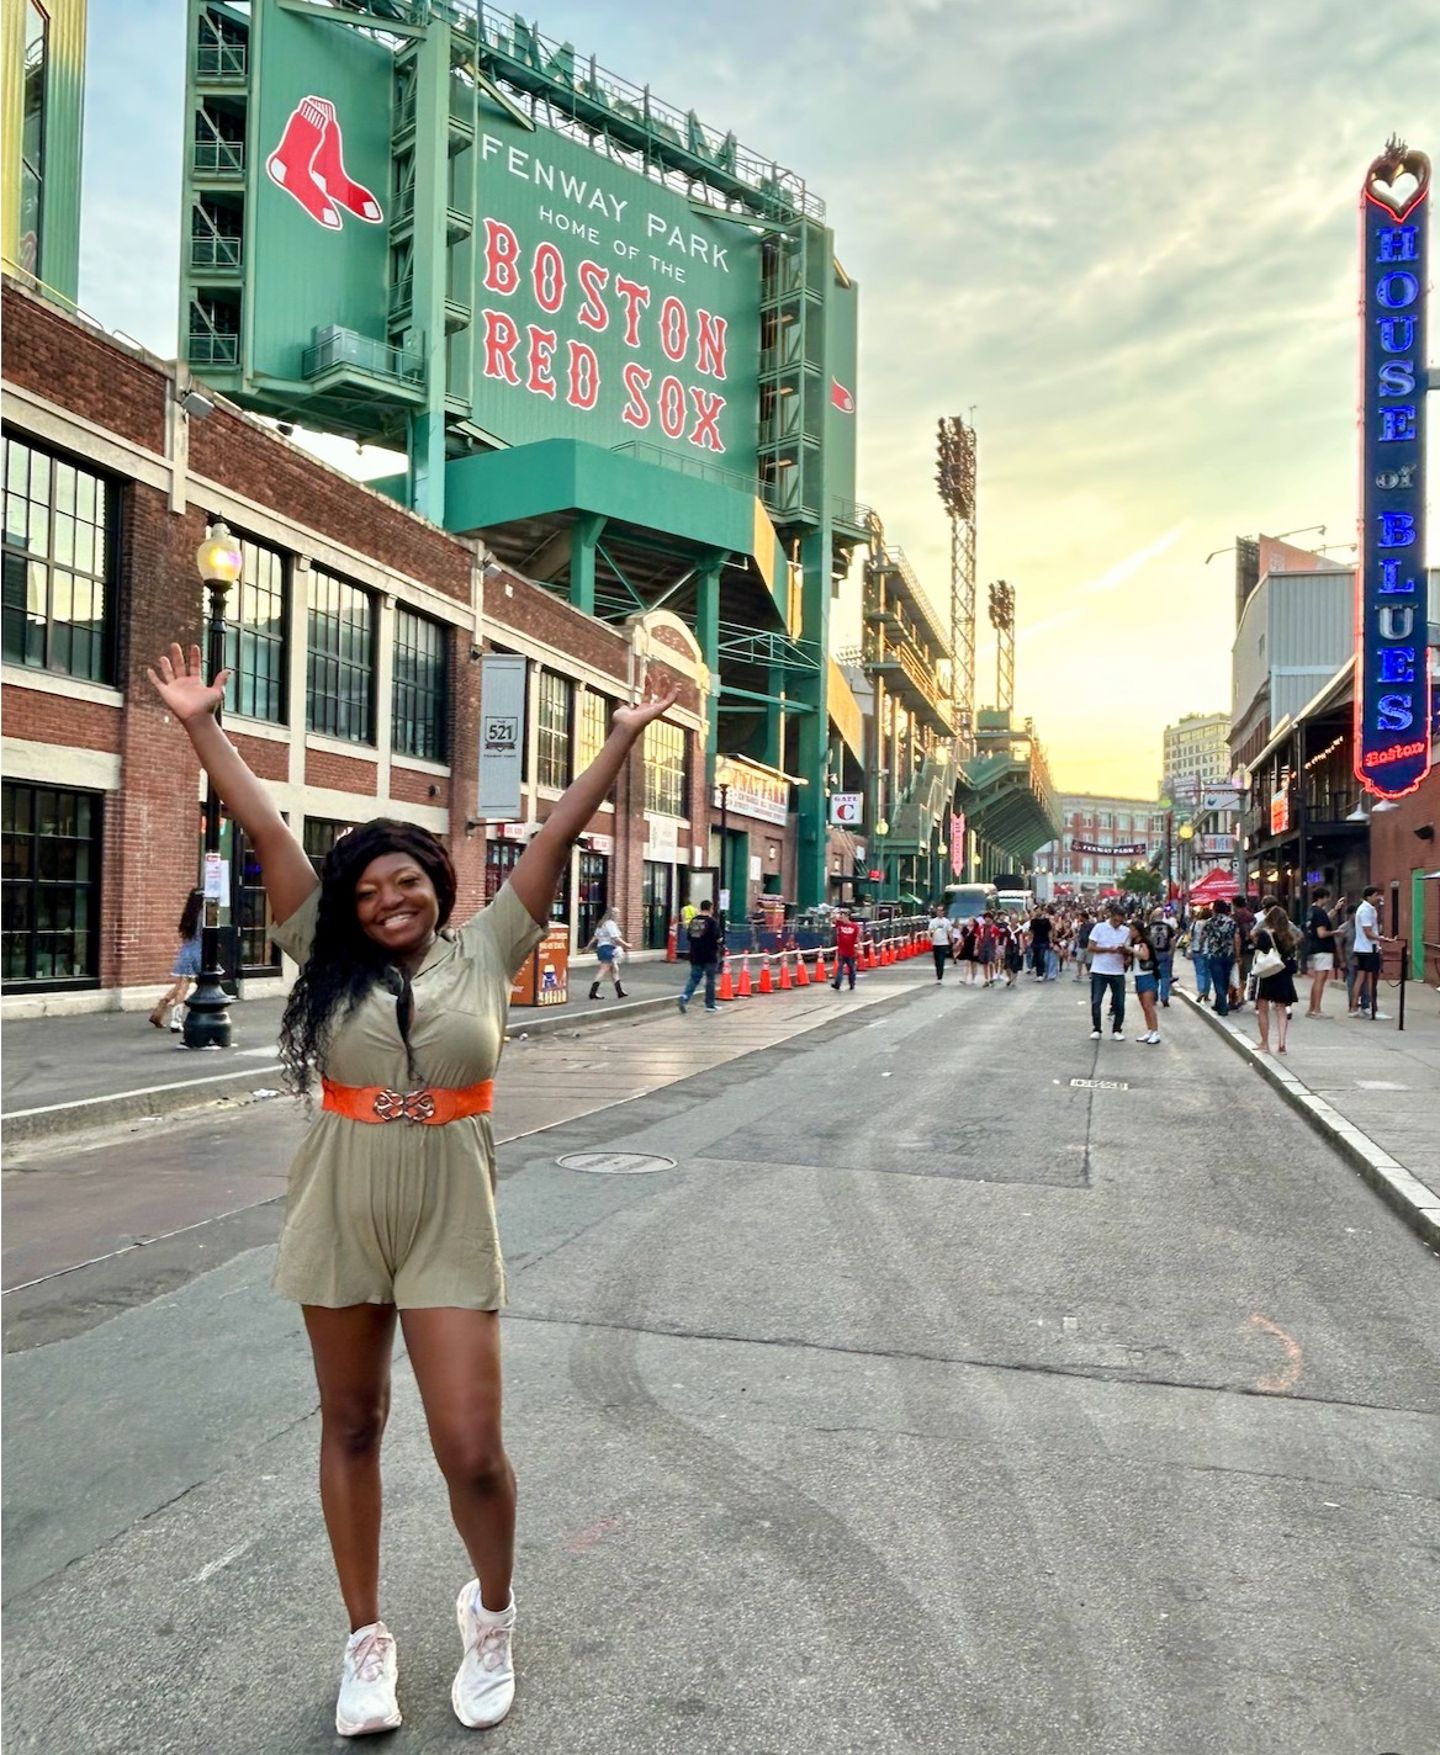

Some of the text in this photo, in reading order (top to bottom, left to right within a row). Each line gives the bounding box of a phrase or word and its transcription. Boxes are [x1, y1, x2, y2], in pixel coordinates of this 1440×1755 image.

[481, 132, 628, 223] FENWAY
[647, 212, 730, 273] PARK
[539, 205, 687, 285] HOME OF THE
[482, 216, 728, 381] BOSTON
[1375, 224, 1421, 443] HOUSE
[480, 307, 727, 454] RED SOX
[1374, 511, 1419, 732] BLUES
[489, 724, 512, 740] 521
[1364, 741, 1425, 767] Boston
[837, 804, 855, 821] C
